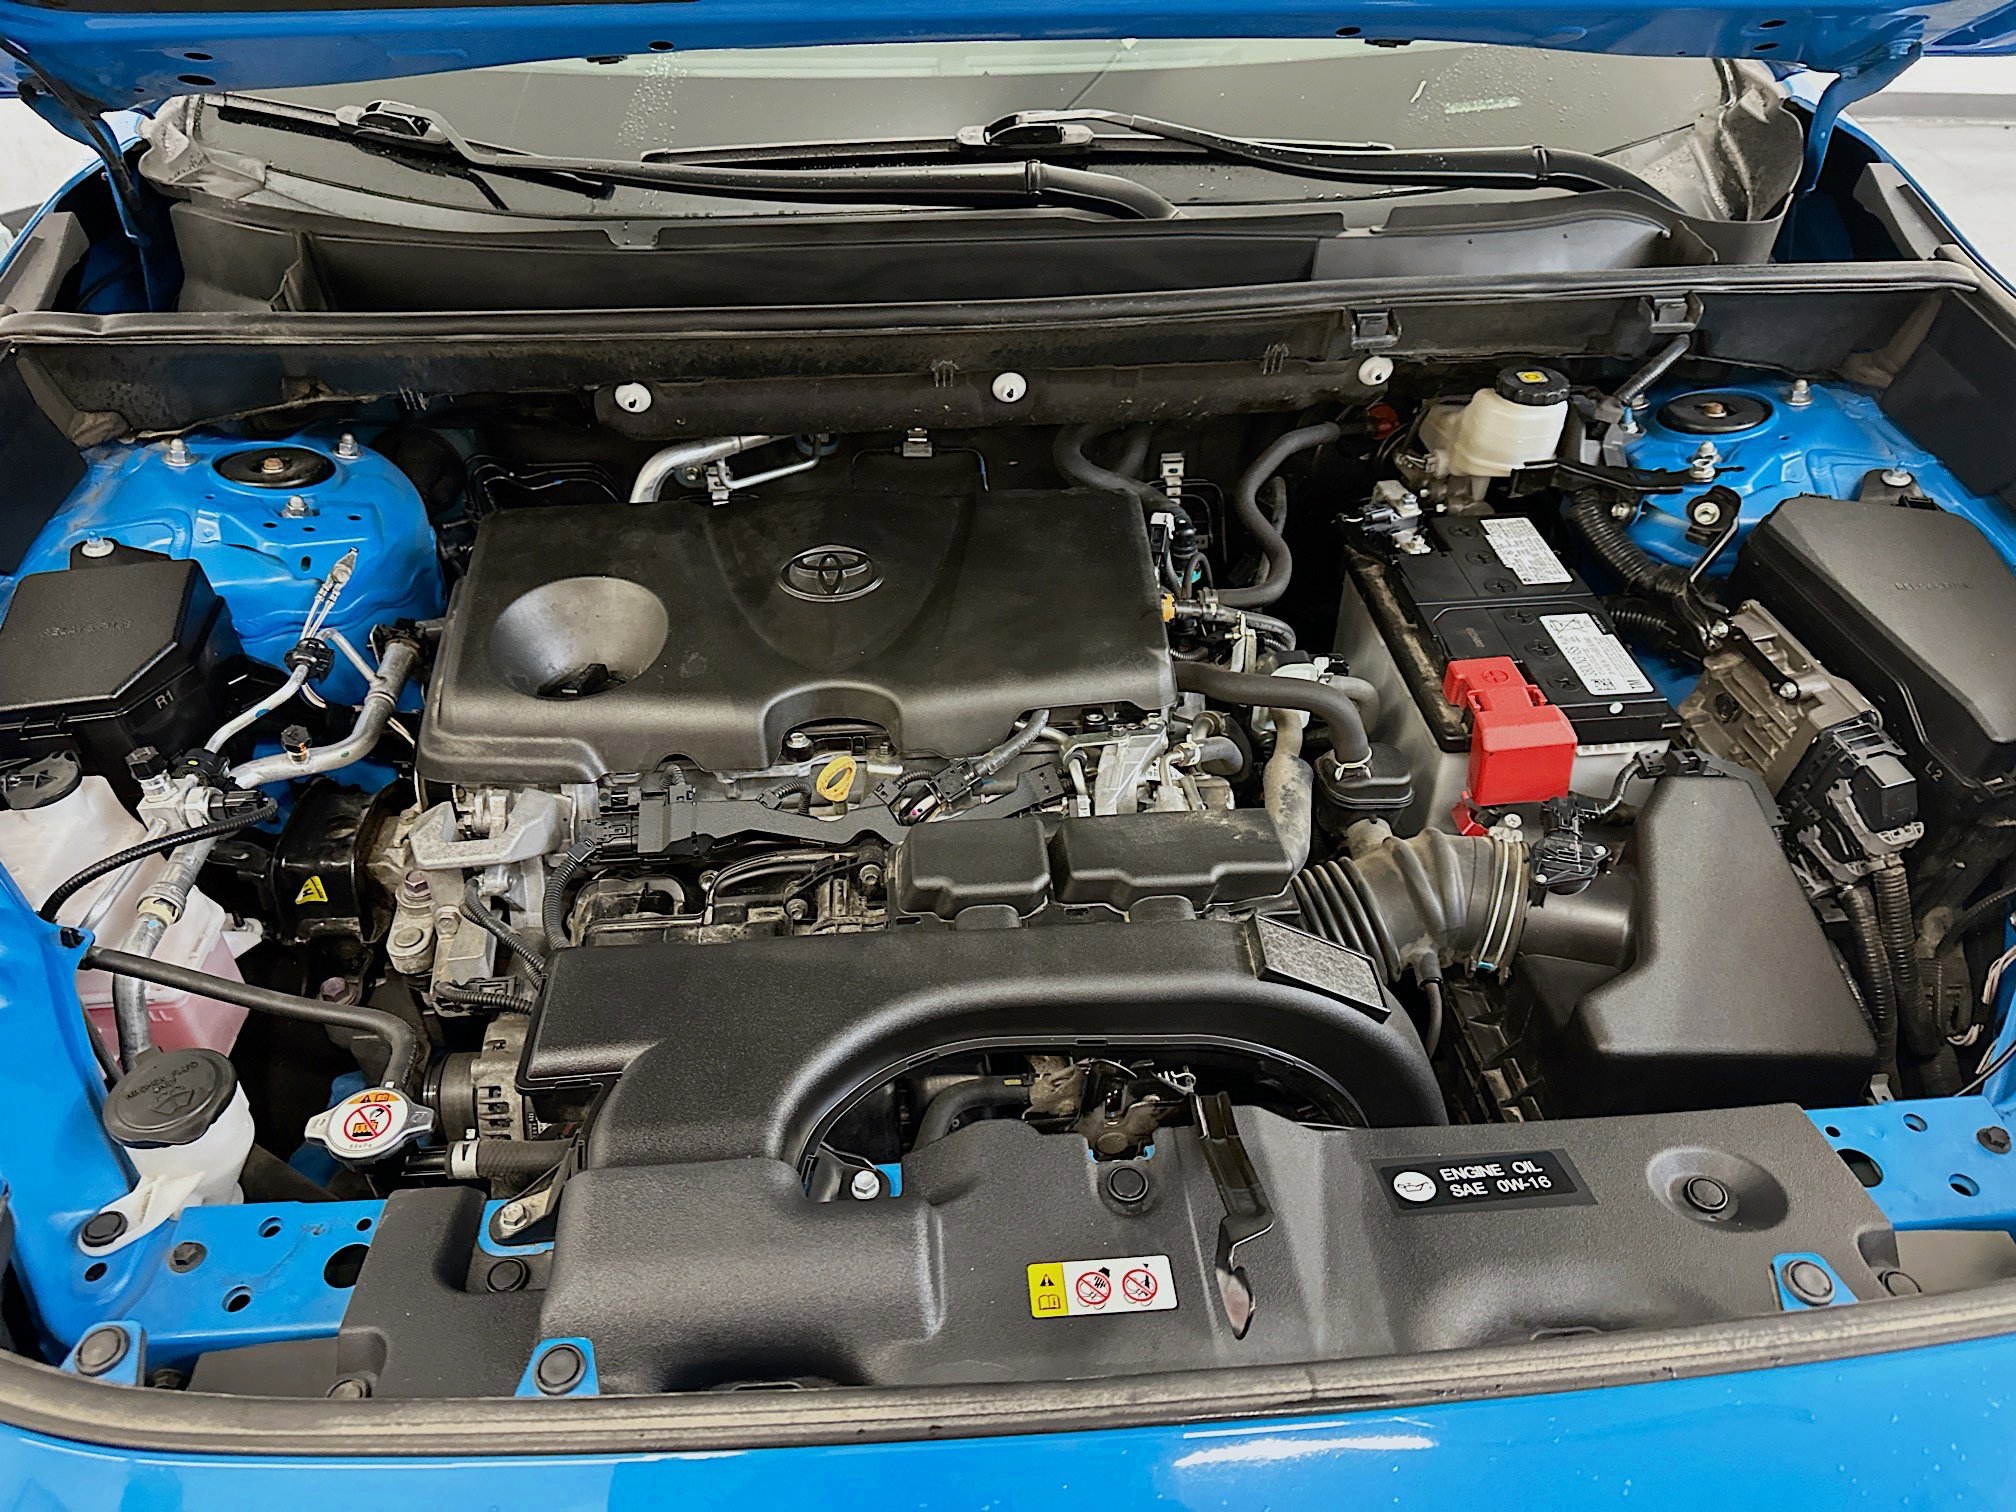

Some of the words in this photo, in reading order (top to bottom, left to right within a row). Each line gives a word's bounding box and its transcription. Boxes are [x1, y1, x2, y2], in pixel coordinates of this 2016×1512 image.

[155, 690, 174, 709] R1
[1925, 760, 1943, 782] L2
[1439, 1163, 1505, 1181] ENGINE
[1511, 1160, 1543, 1175] OIL
[1450, 1182, 1488, 1197] SAE
[1496, 1175, 1552, 1193] 0W-16
